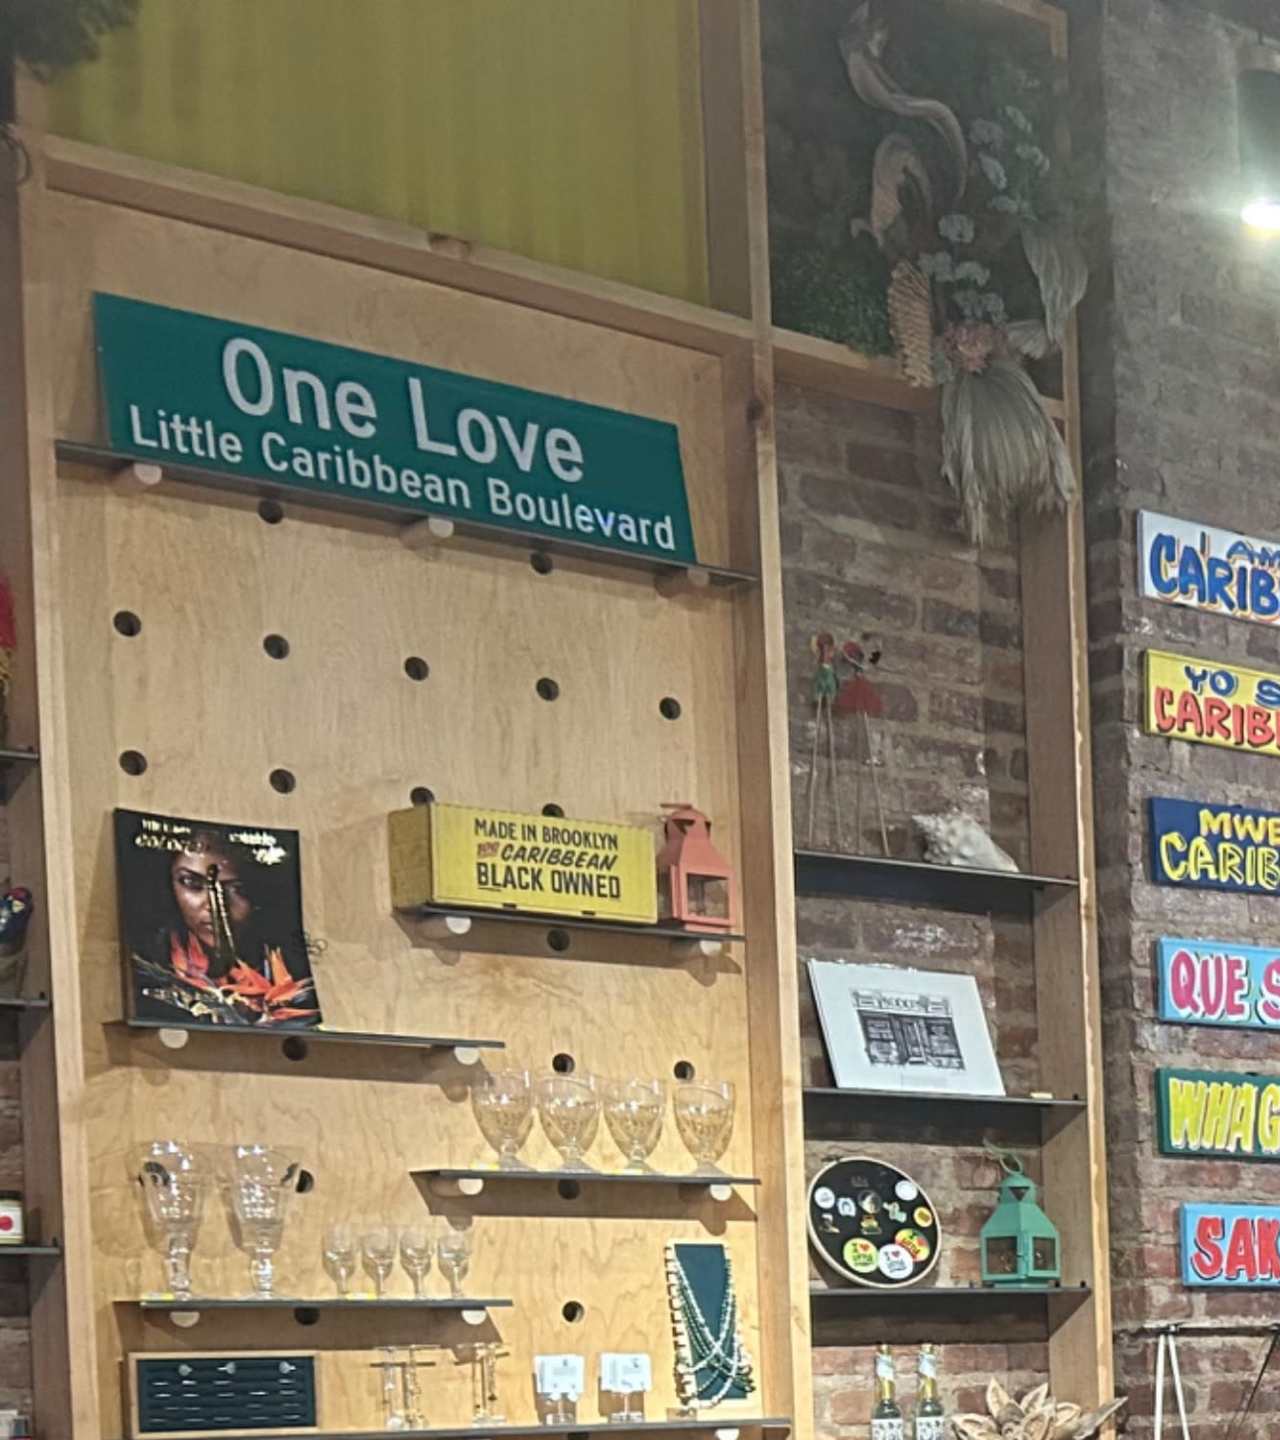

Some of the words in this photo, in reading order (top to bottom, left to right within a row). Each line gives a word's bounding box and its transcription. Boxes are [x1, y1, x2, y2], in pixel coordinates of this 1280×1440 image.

[222, 338, 377, 439] One
[408, 377, 585, 483] Love
[130, 405, 243, 463] Little
[262, 432, 470, 509] Caribbean
[489, 479, 676, 551] Boulevard
[1184, 666, 1238, 697] YO
[474, 818, 516, 841] MADE
[521, 823, 537, 841] IN
[542, 826, 619, 851] BROOKLYN
[500, 843, 619, 872] CARIBBEAN
[476, 862, 544, 892] BLACK
[551, 873, 621, 899] OWNED
[1170, 950, 1249, 1019] QUE
